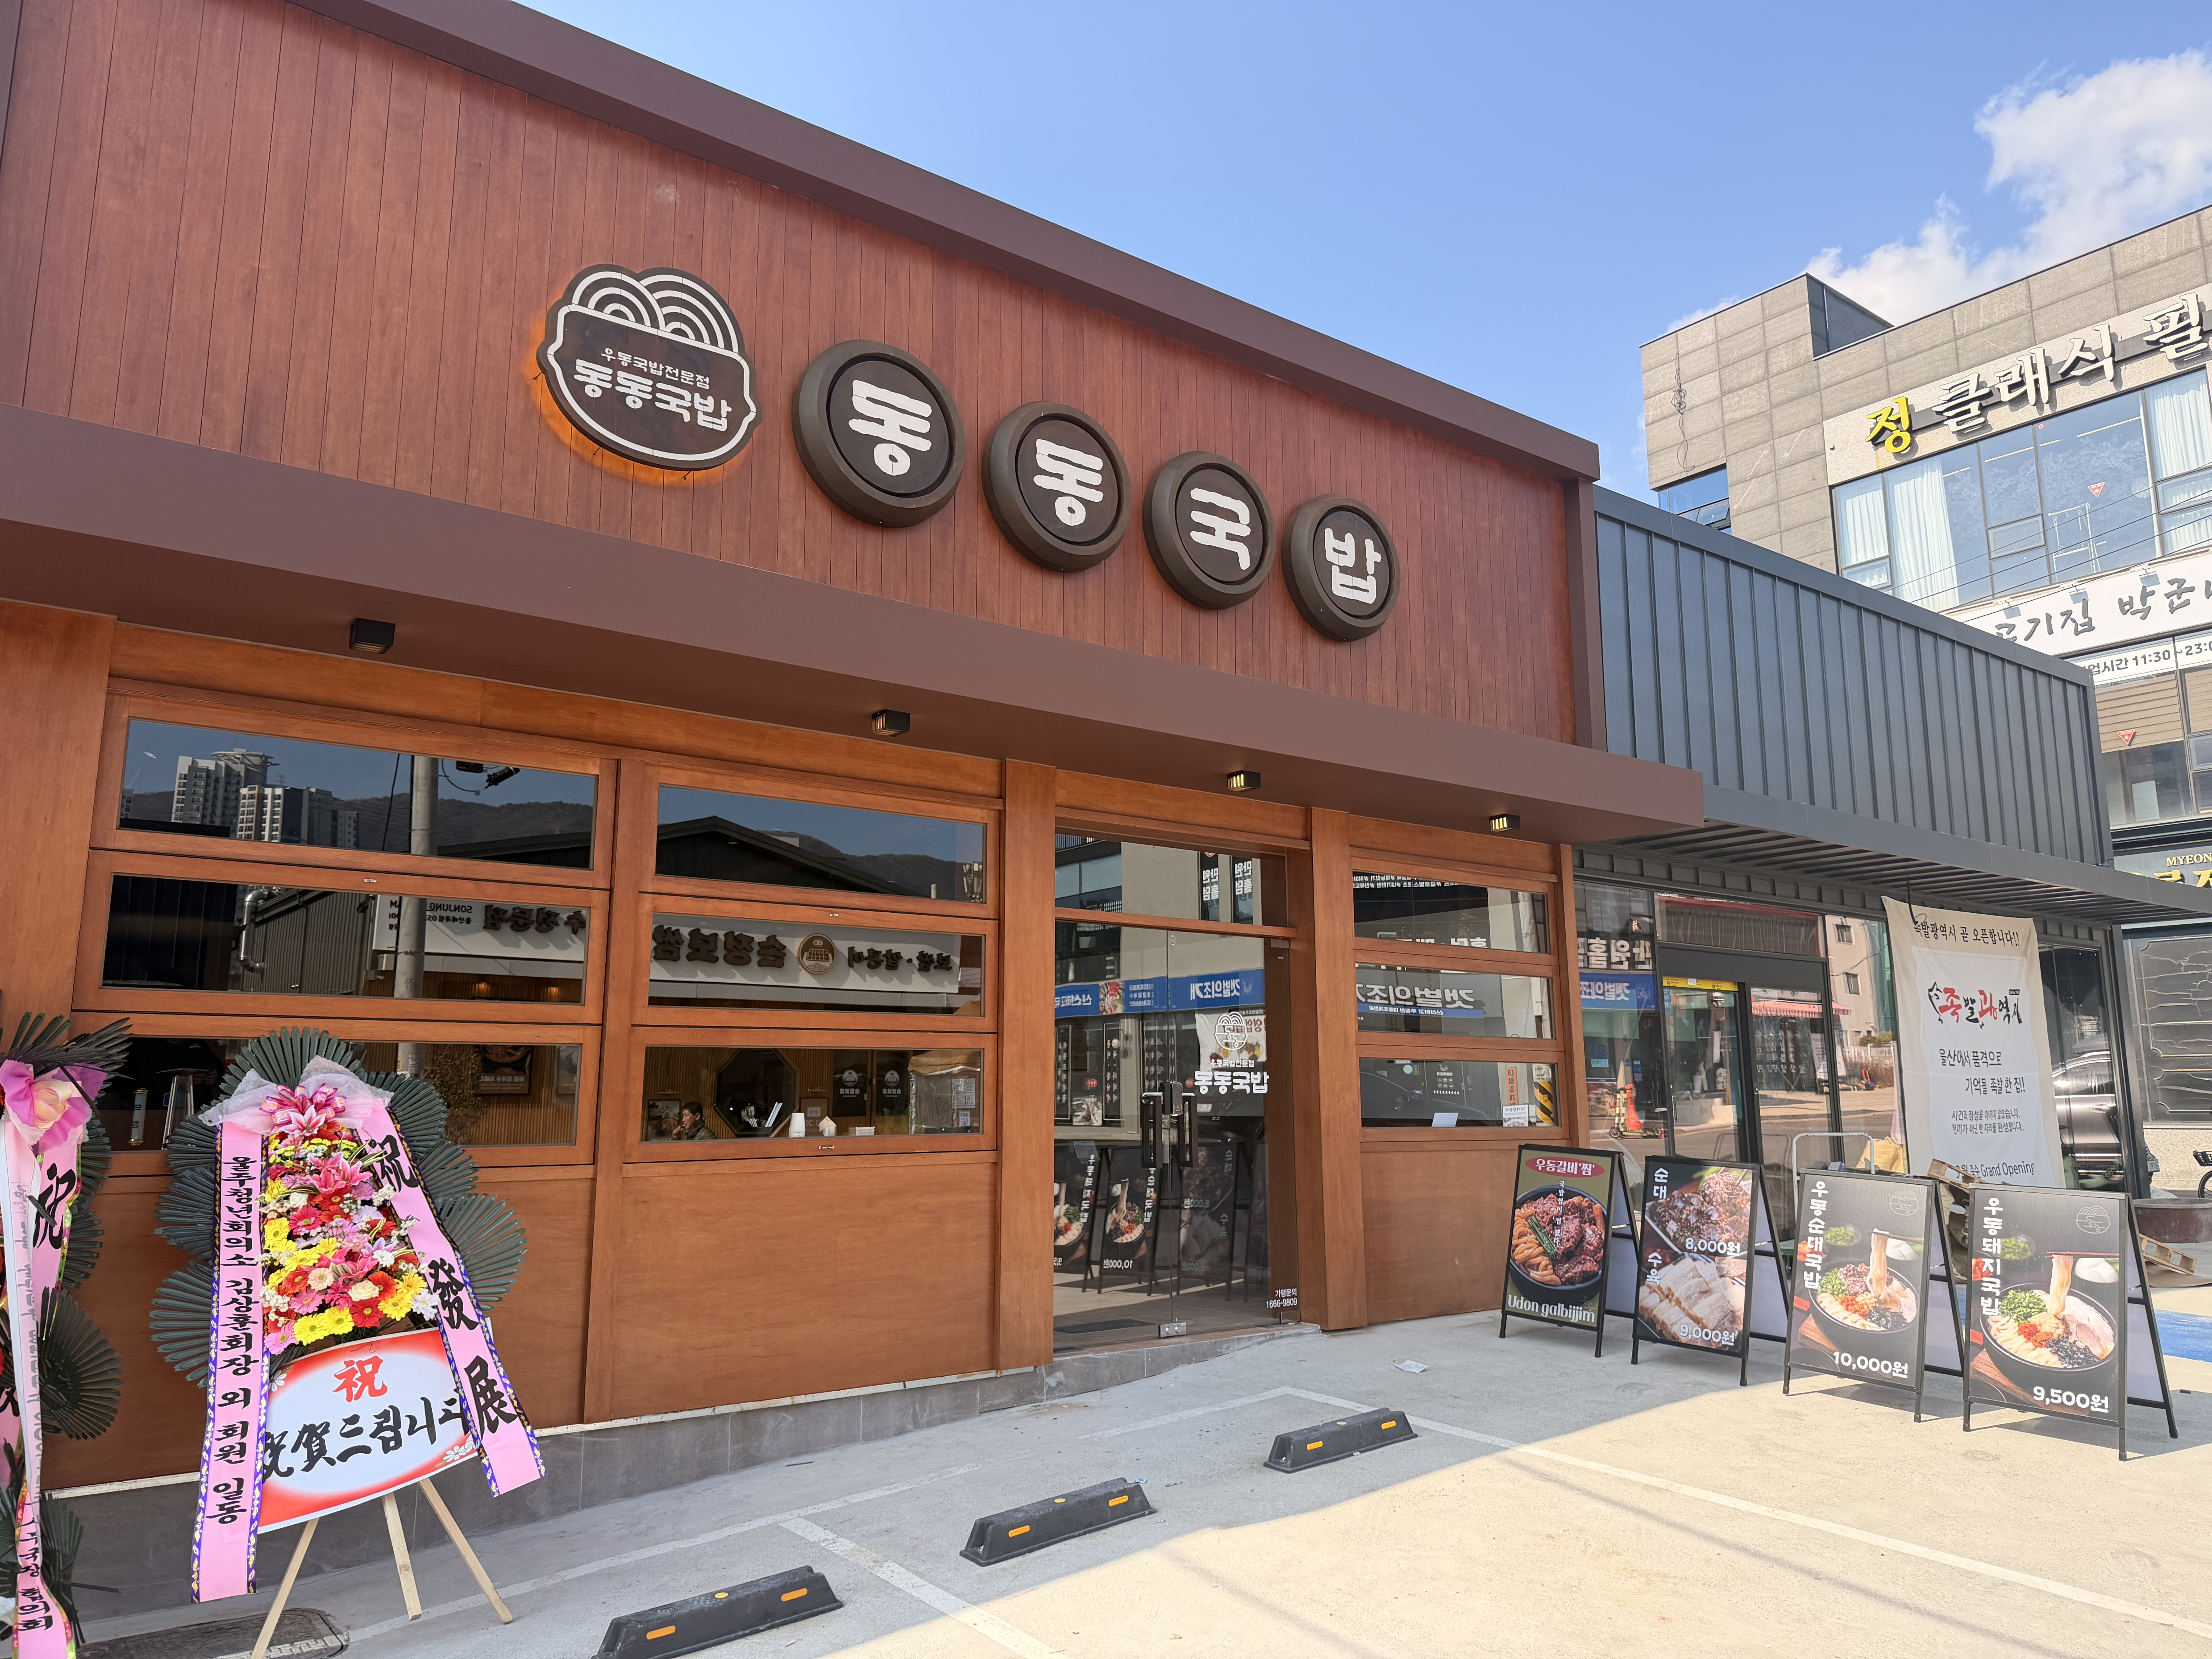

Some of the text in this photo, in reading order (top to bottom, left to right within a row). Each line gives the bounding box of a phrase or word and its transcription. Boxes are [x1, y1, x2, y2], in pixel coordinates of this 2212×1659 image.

[601, 348, 709, 389] 우동국밥전문점
[574, 359, 732, 432] 동동국밥
[1865, 396, 1911, 453] 정
[1932, 323, 2114, 433] 클래식
[2118, 577, 2212, 620] 박군
[2083, 657, 2129, 675] 업시간
[1960, 926, 1968, 942] 곧
[1973, 927, 2020, 947] 오픈합니다!!
[1209, 1059, 1255, 1068] 우동국밥전문점
[1972, 1050, 2002, 1068] 품격으로
[1194, 1070, 1269, 1094] 동동국밥
[1990, 1077, 2003, 1094] 족발
[2005, 1077, 2012, 1094] 한
[1968, 1109, 1983, 1121] 정성을
[1653, 1167, 1668, 1199] 순대
[1981, 1163, 2001, 1177] Grand
[2002, 1161, 2034, 1178] Opening
[1685, 1238, 1740, 1257] 8,000원
[1803, 1181, 1828, 1289] 우동순대국밥
[1647, 1252, 1662, 1285] 수육
[1980, 1197, 2003, 1316] 우동돼지국밥
[1266, 1298, 1298, 1309] 1666-9809
[1275, 1287, 1297, 1298] 가맹문의
[1508, 1294, 1539, 1312] Udon
[1541, 1303, 1595, 1323] galbijjim
[205, 1156, 260, 1524] 울주청년회의소 김상훈 회장 외 회원 일동
[1680, 1324, 1735, 1346] 9,000원
[1833, 1351, 1908, 1378] 10,000원
[332, 1355, 388, 1403] 祝
[2032, 1386, 2109, 1413] 9,500원
